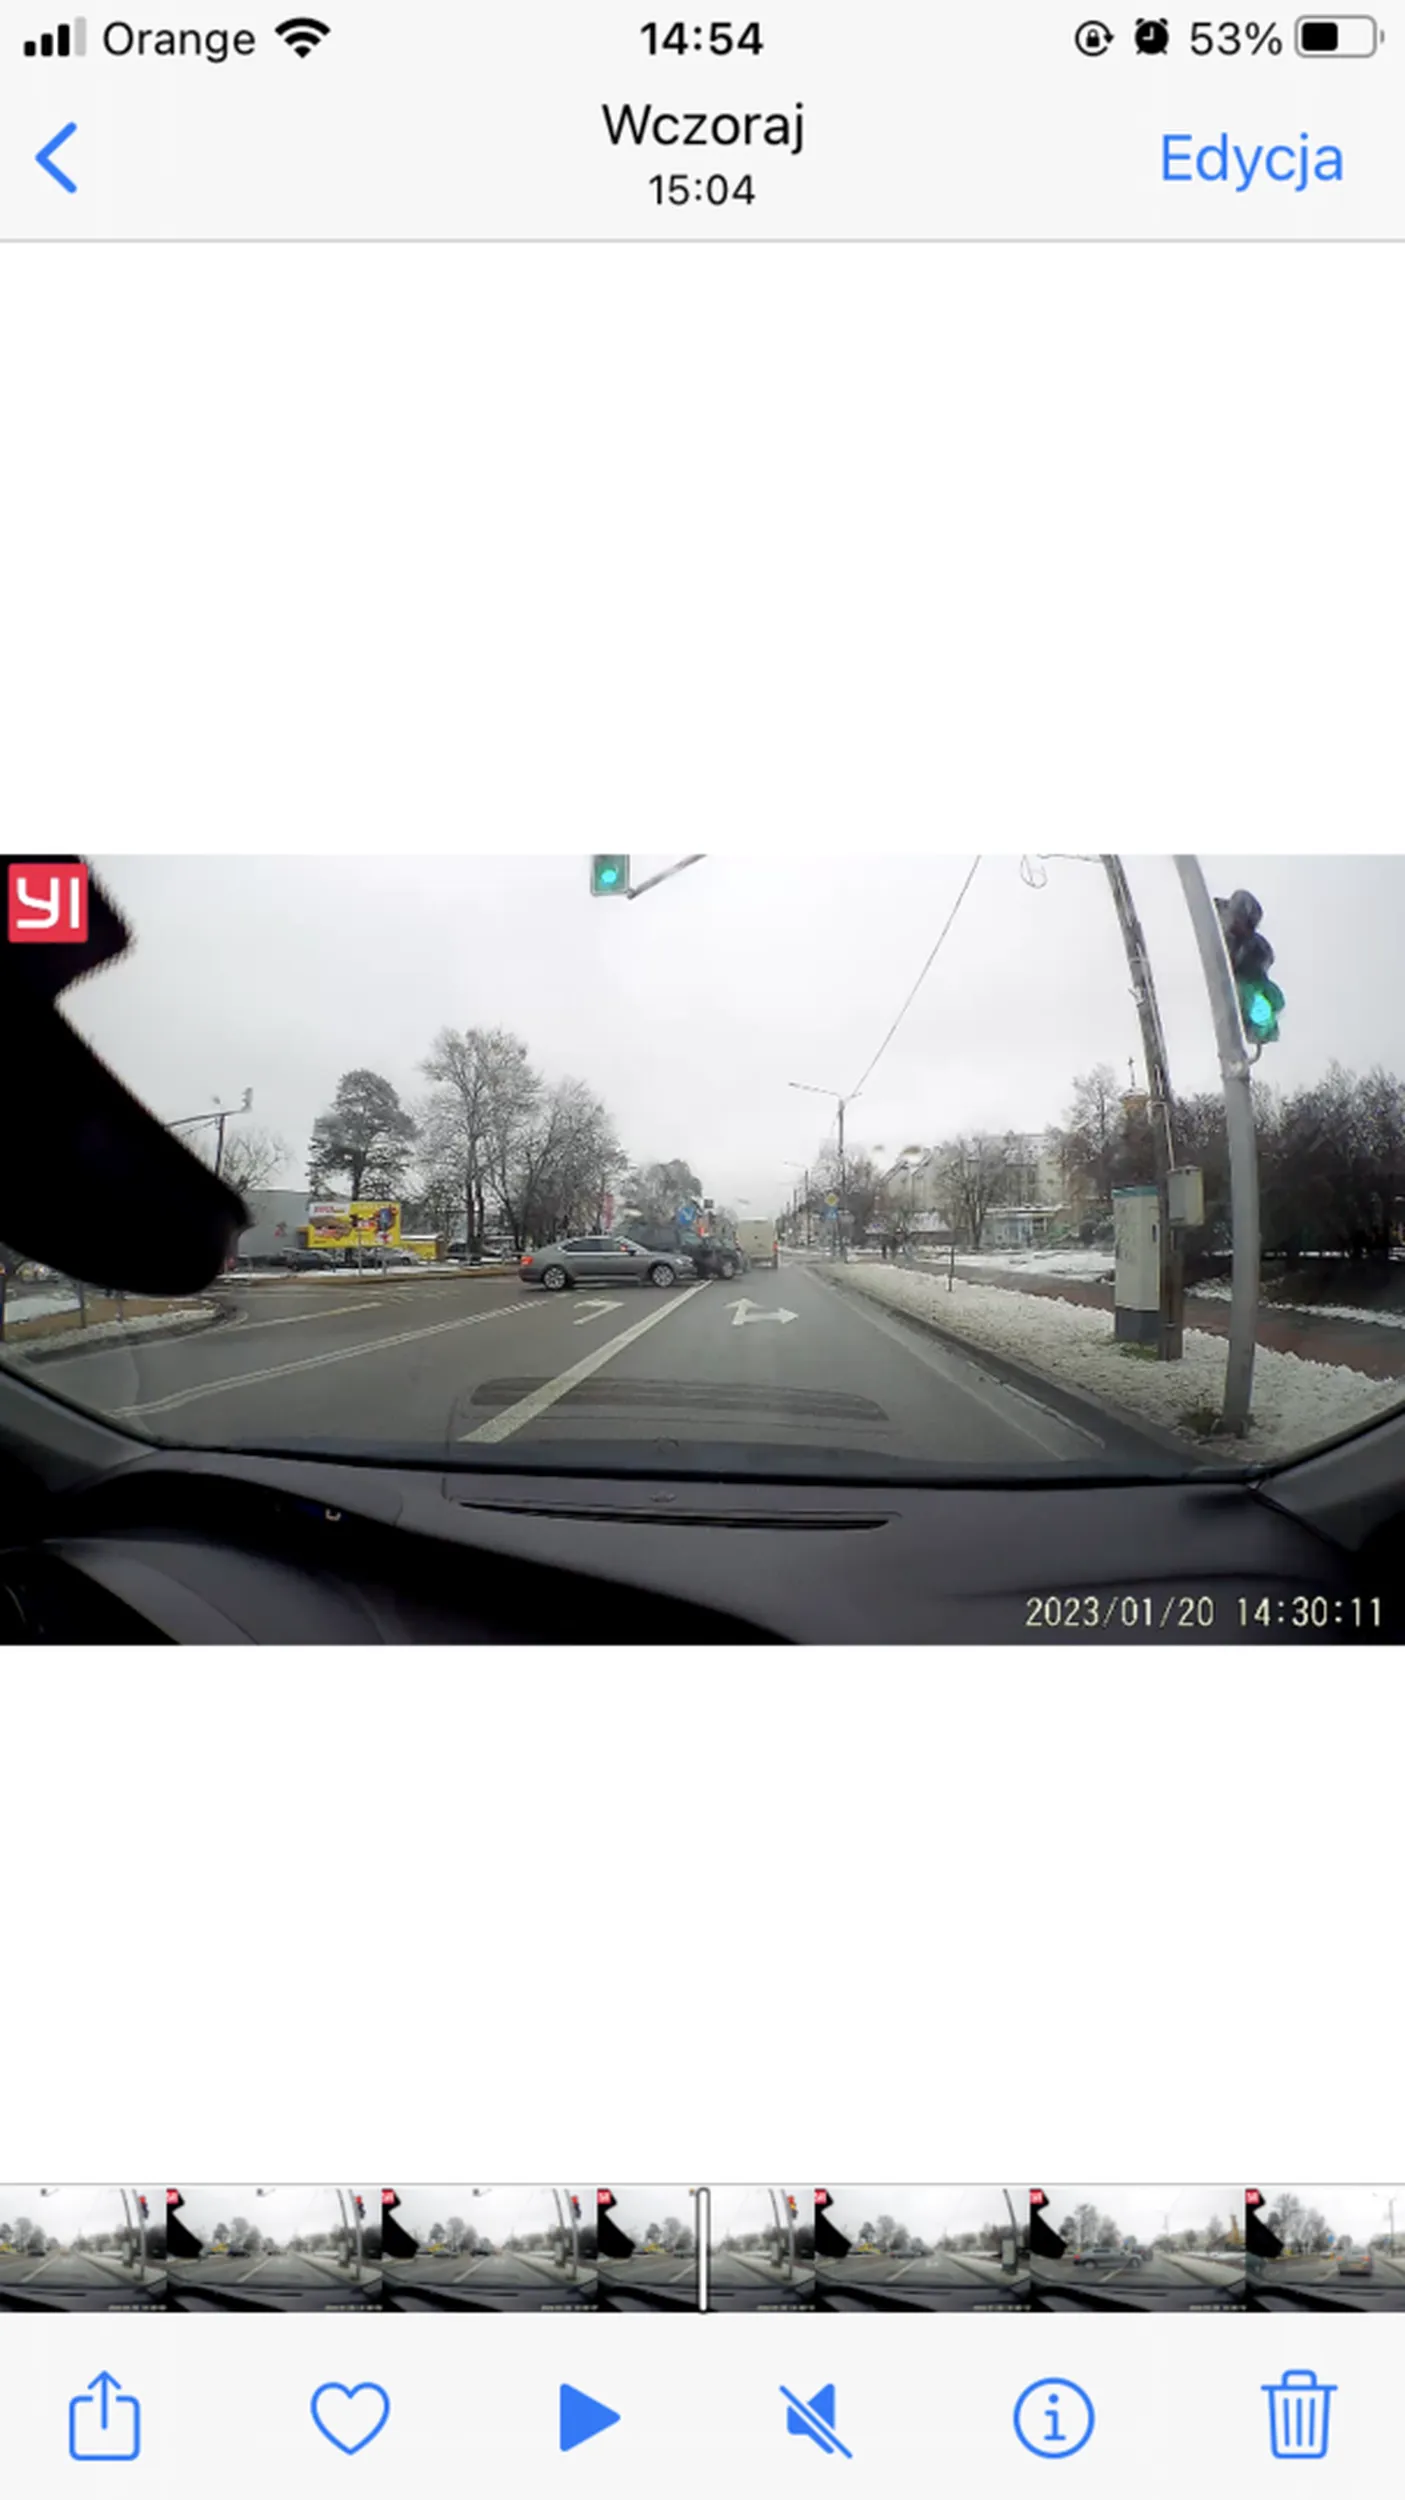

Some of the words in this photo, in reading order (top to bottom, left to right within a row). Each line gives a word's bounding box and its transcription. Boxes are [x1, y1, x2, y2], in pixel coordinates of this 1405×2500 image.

[103, 21, 256, 64] Orange
[640, 21, 764, 56] 14:54
[1190, 21, 1283, 56] 53%
[601, 101, 804, 156] Wczoraj
[1162, 132, 1343, 193] Edycja
[649, 173, 756, 206] 15:04
